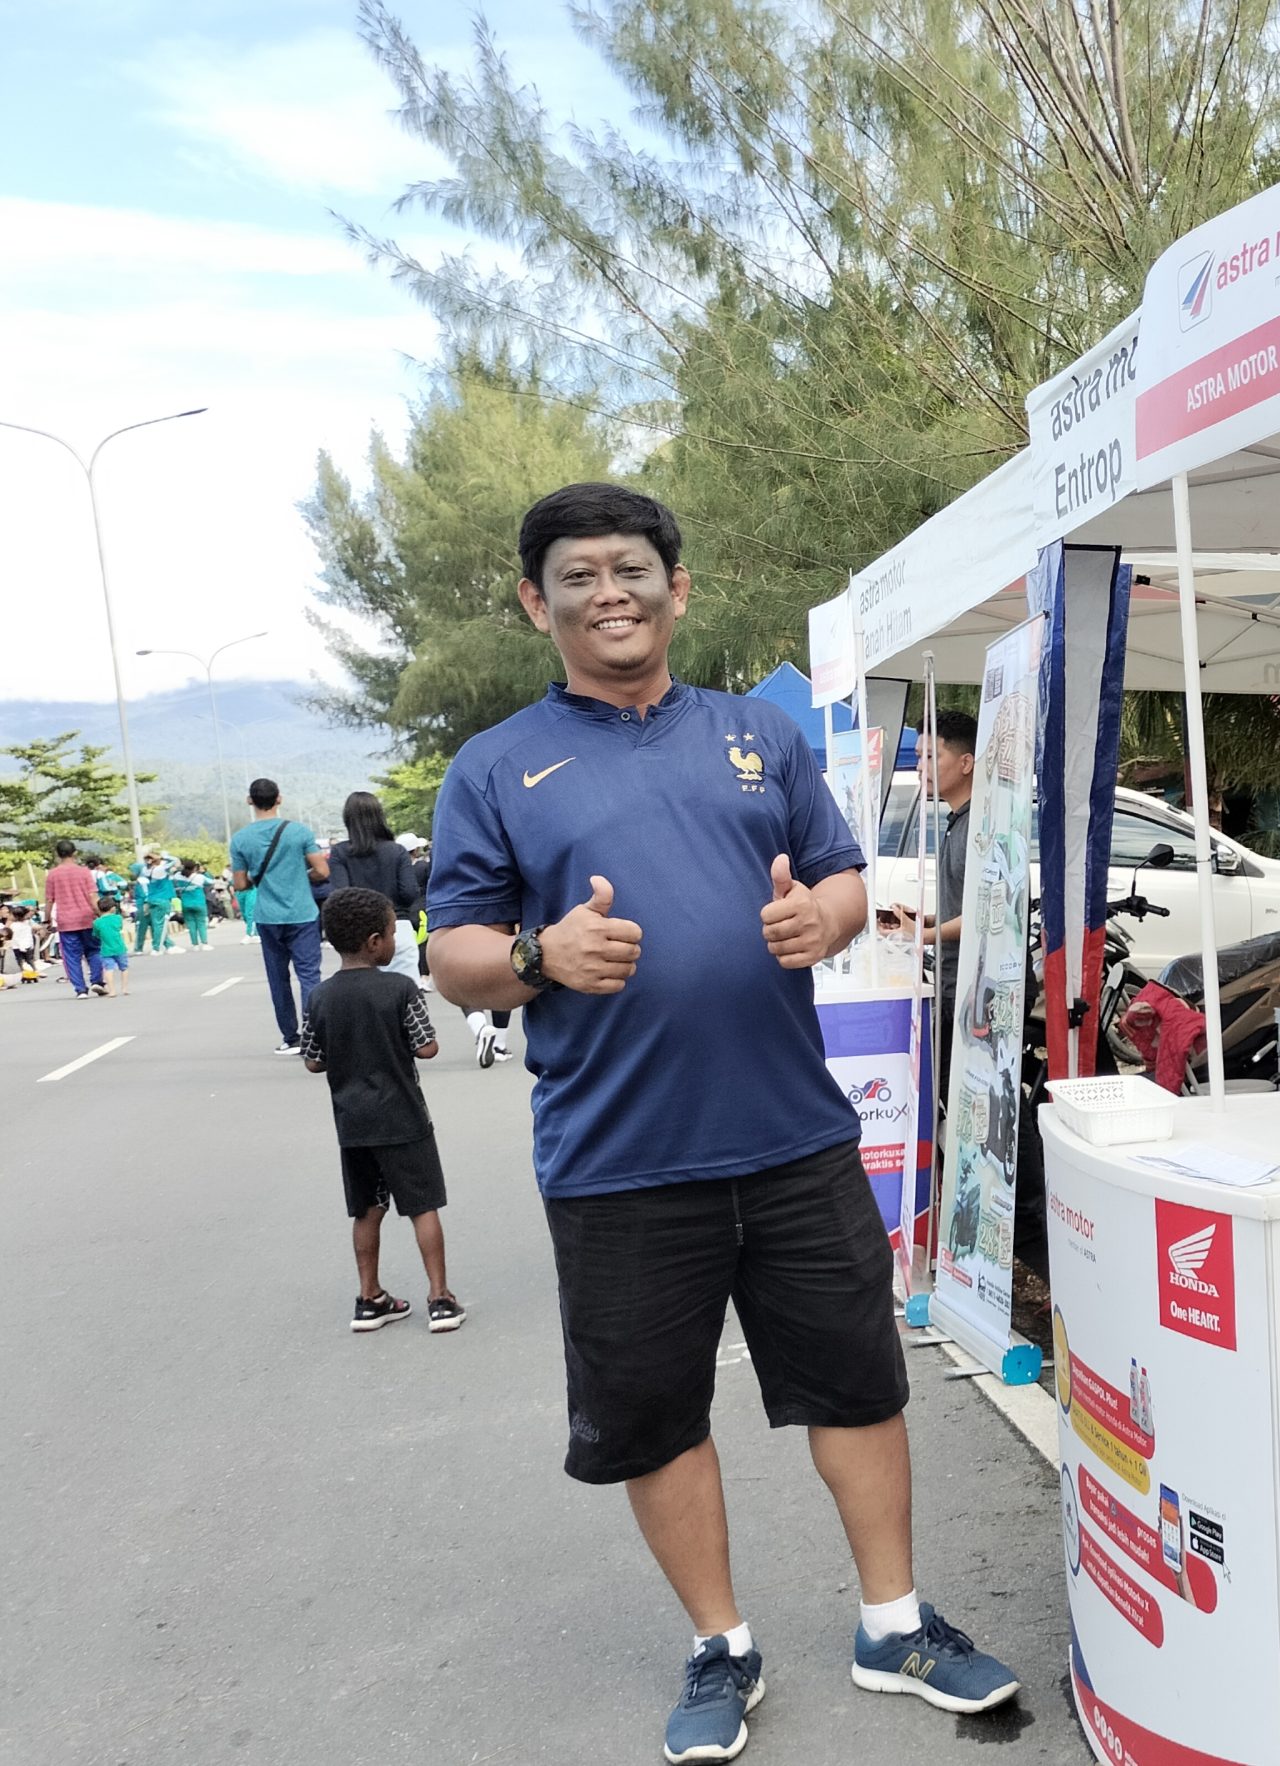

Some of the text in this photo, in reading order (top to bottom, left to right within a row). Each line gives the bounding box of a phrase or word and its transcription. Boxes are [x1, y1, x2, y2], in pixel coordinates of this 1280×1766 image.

[1217, 237, 1270, 290] astra
[1186, 373, 1226, 413] ASTRA
[1227, 345, 1278, 391] MOTOR
[1051, 368, 1103, 441] astra
[1055, 438, 1122, 520] Entrop
[860, 560, 906, 615] astra motor
[864, 606, 912, 658] anah Hitam
[1066, 1203, 1095, 1241] motor
[1169, 1271, 1220, 1298] HONDA
[1170, 1300, 1221, 1332] One HEART.
[1136, 1526, 1157, 1548] proses
[1196, 1520, 1222, 1541] Google Play
[1200, 1544, 1222, 1562] App Store
